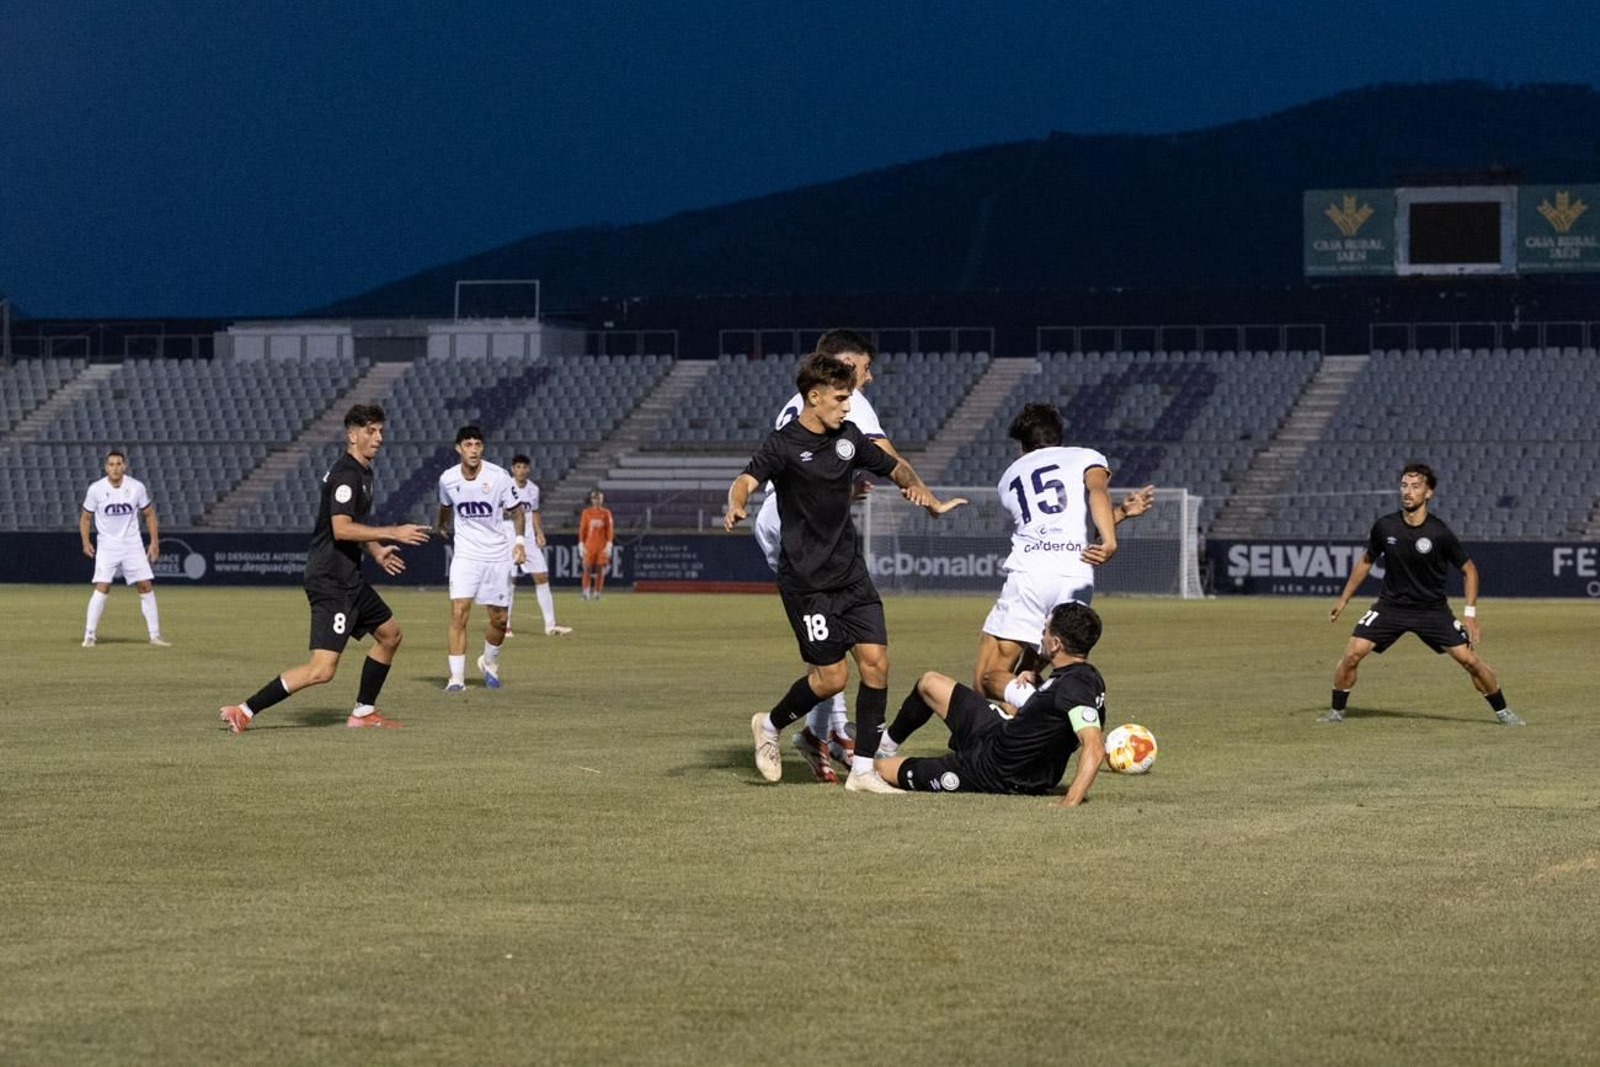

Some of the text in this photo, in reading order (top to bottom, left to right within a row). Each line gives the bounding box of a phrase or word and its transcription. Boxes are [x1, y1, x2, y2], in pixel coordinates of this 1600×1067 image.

[1009, 464, 1067, 525] 15
[1023, 540, 1082, 554] calderón
[868, 553, 1008, 577] cDonald's
[333, 612, 347, 634] 8
[803, 613, 829, 642] 18
